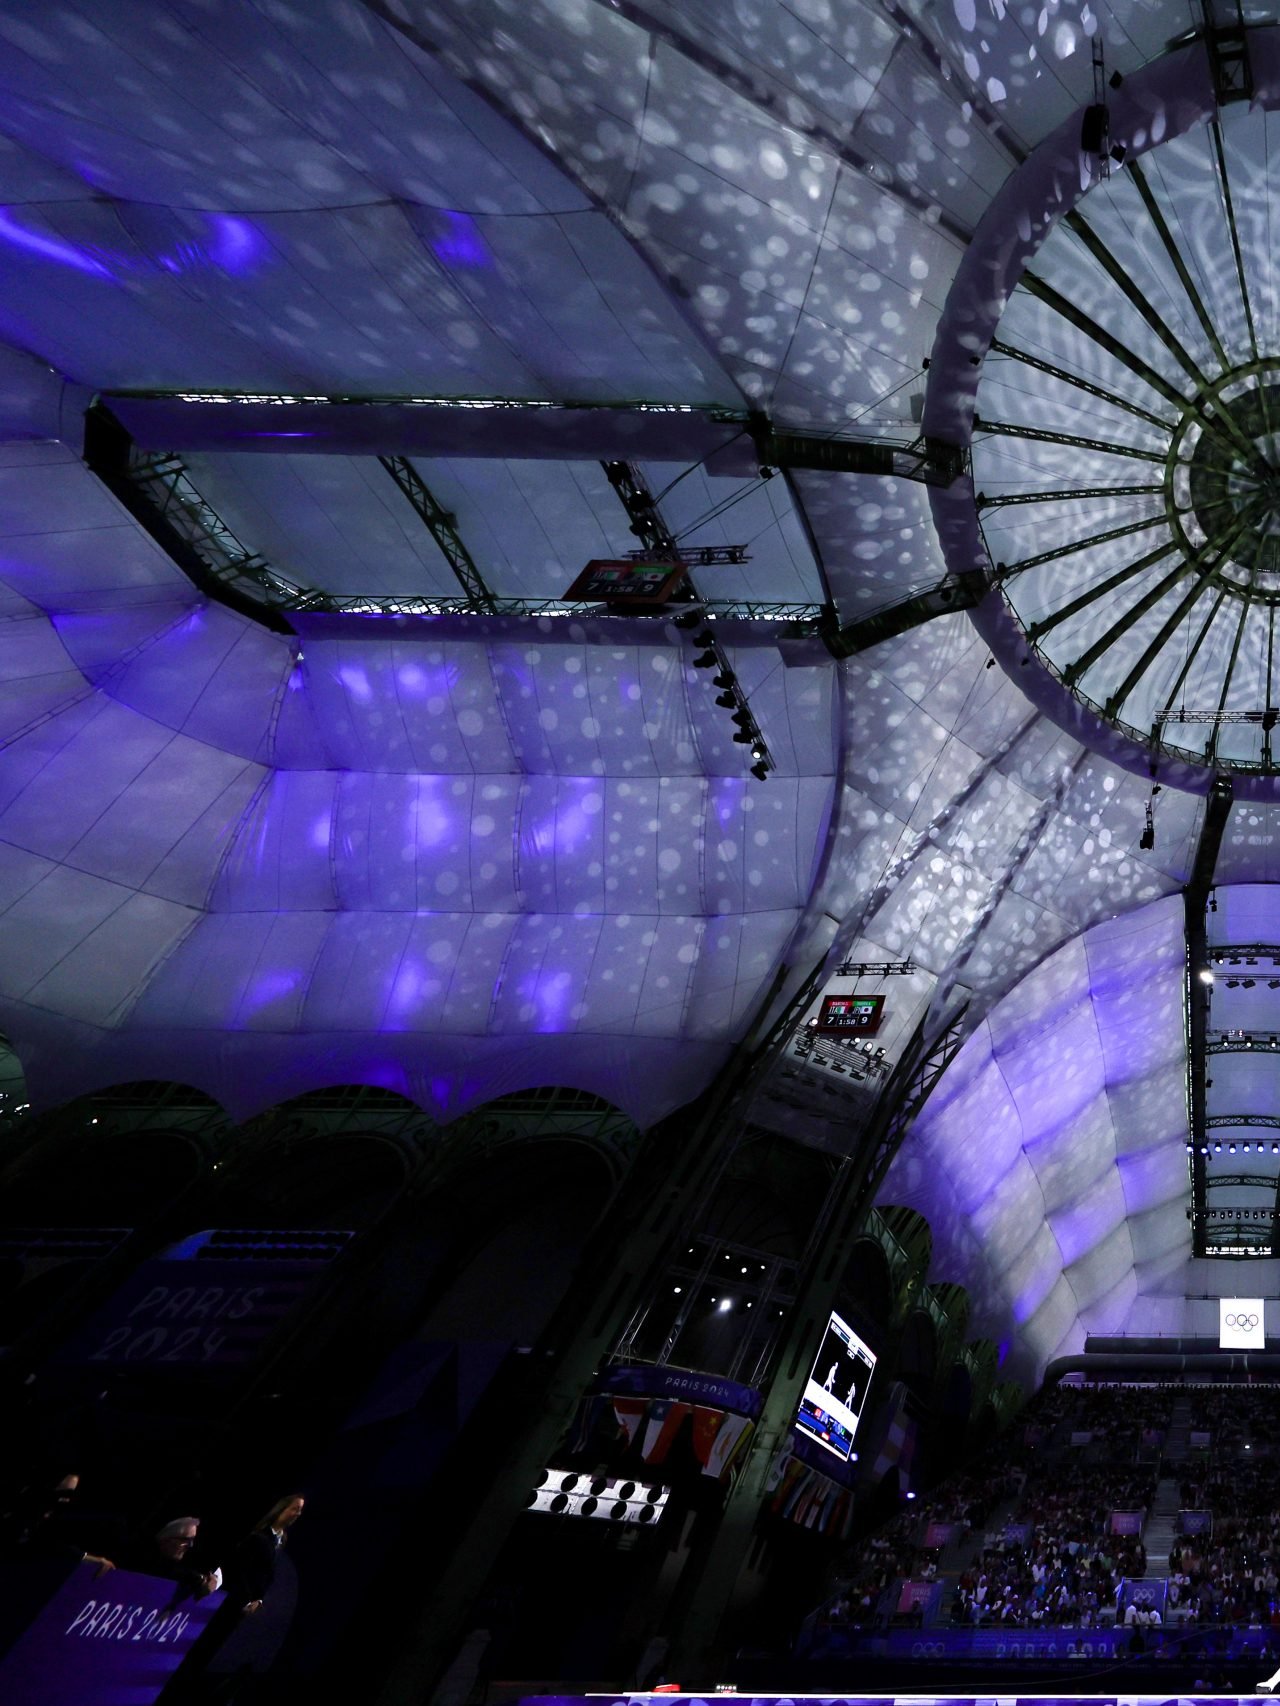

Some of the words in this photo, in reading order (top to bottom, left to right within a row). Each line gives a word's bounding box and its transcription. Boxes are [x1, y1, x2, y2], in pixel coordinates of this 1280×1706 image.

[861, 1016, 868, 1024] 9
[127, 1286, 265, 1319] PARIS
[88, 1326, 226, 1360] 2024
[665, 1376, 700, 1391] PARIS
[701, 1383, 730, 1398] 2024
[64, 1600, 143, 1640] PARIS
[131, 1608, 190, 1643] 2024
